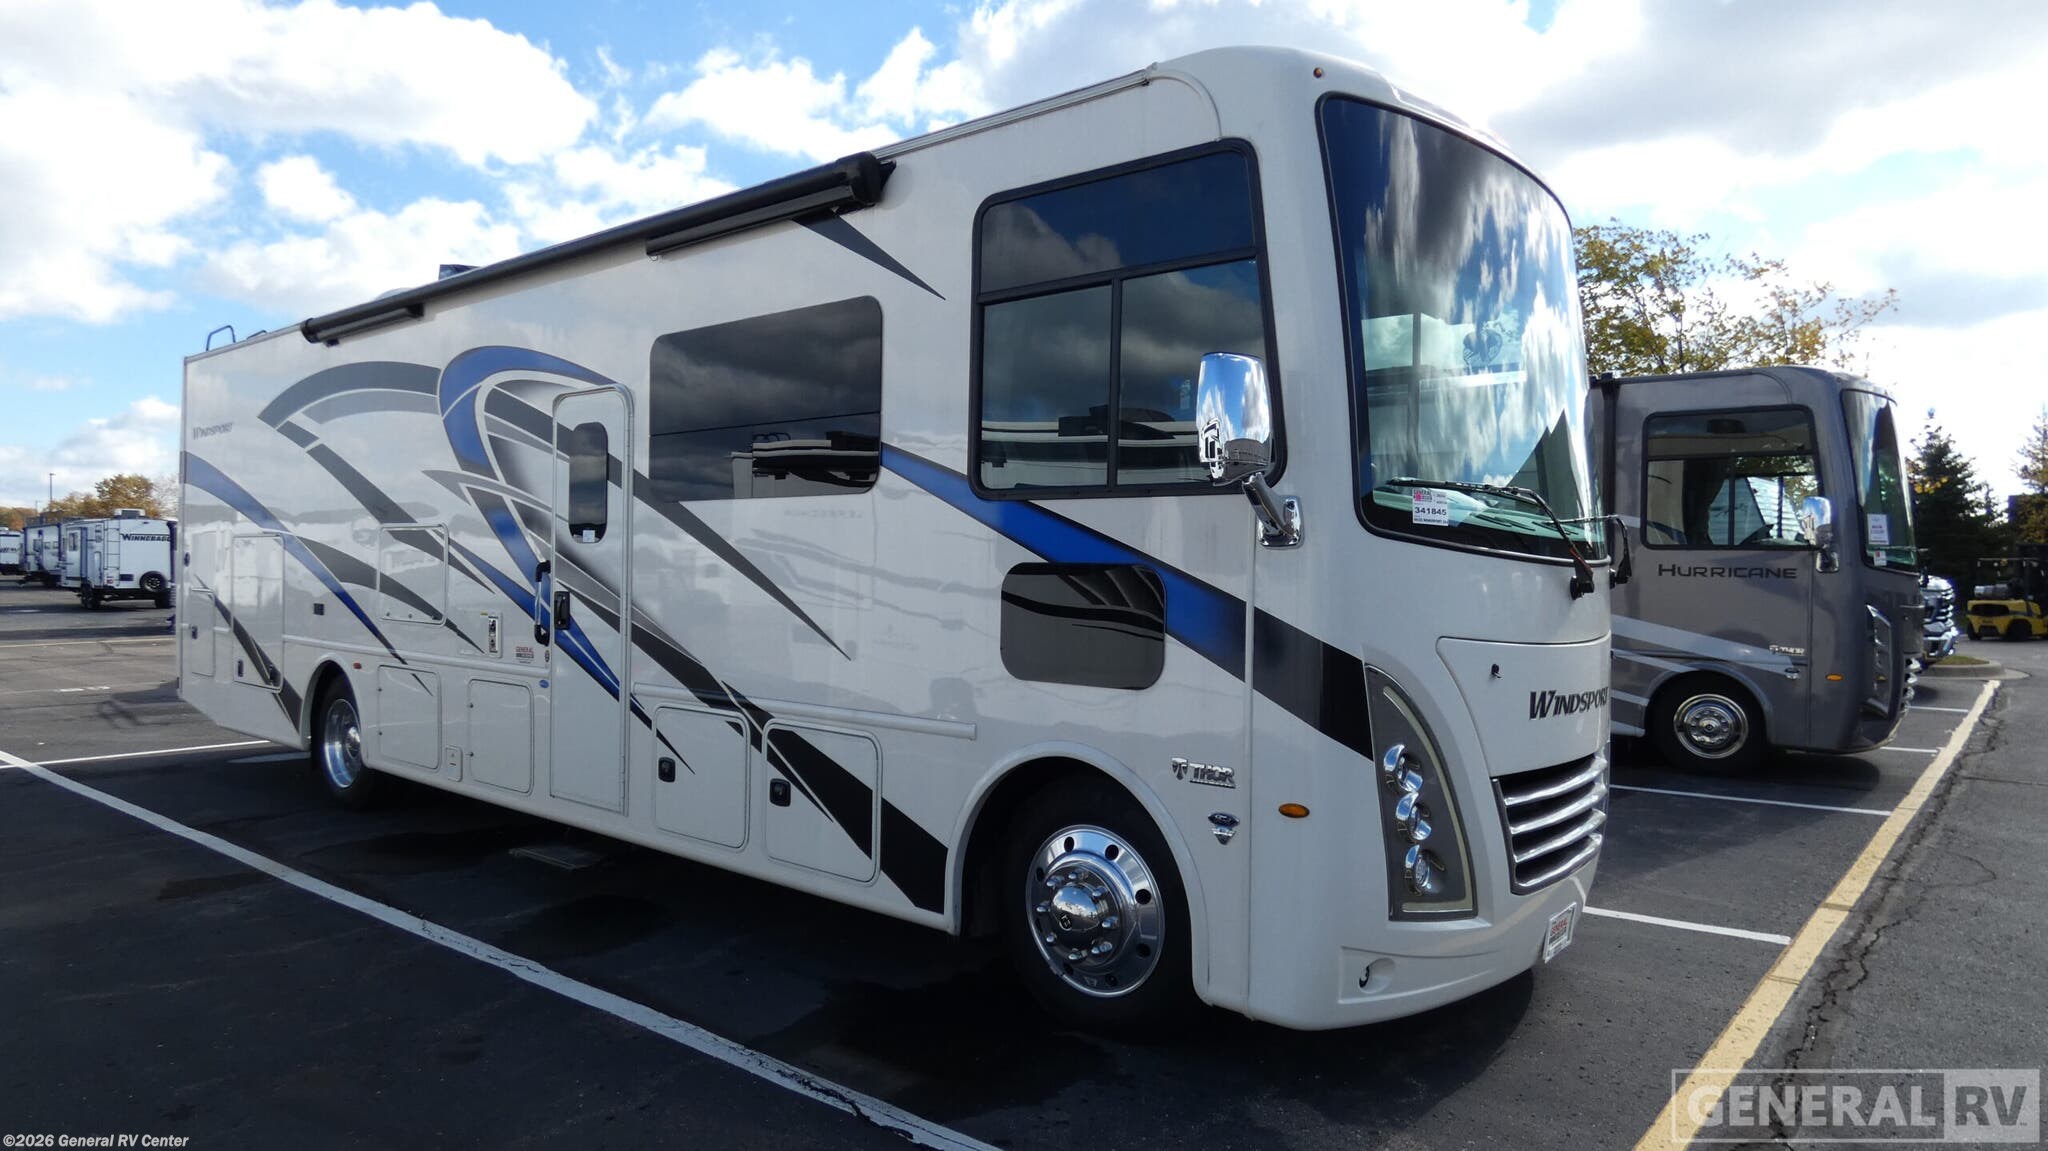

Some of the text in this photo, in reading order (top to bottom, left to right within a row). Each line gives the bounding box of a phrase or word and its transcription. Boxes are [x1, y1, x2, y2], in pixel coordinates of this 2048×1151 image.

[1414, 506, 1447, 516] 341845
[1658, 563, 1797, 579] HURRICANE
[1529, 686, 1609, 720] WINDSPORT
[1189, 762, 1235, 785] THOR
